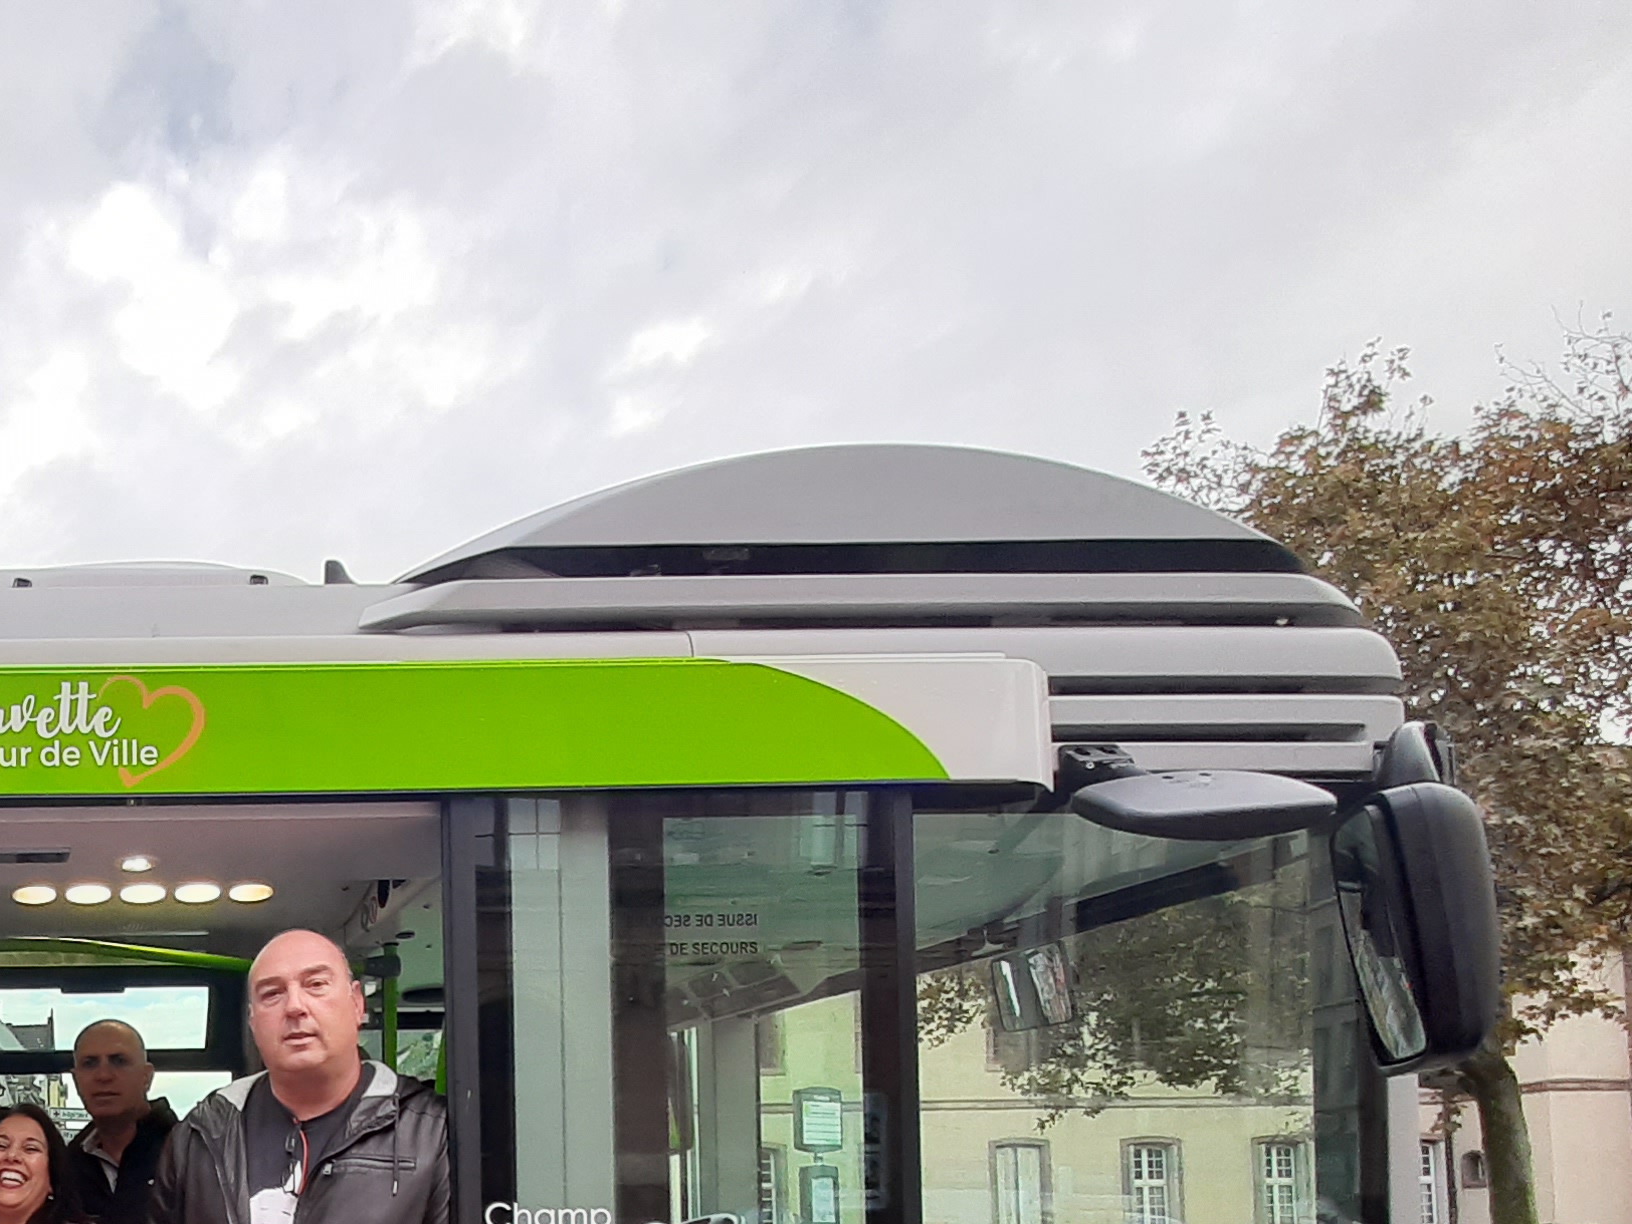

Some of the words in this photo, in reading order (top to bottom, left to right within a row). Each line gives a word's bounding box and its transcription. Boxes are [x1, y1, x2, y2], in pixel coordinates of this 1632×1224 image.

[39, 740, 81, 767] de
[88, 738, 159, 766] Ville
[670, 942, 689, 956] DE
[691, 942, 758, 955] SECOURS
